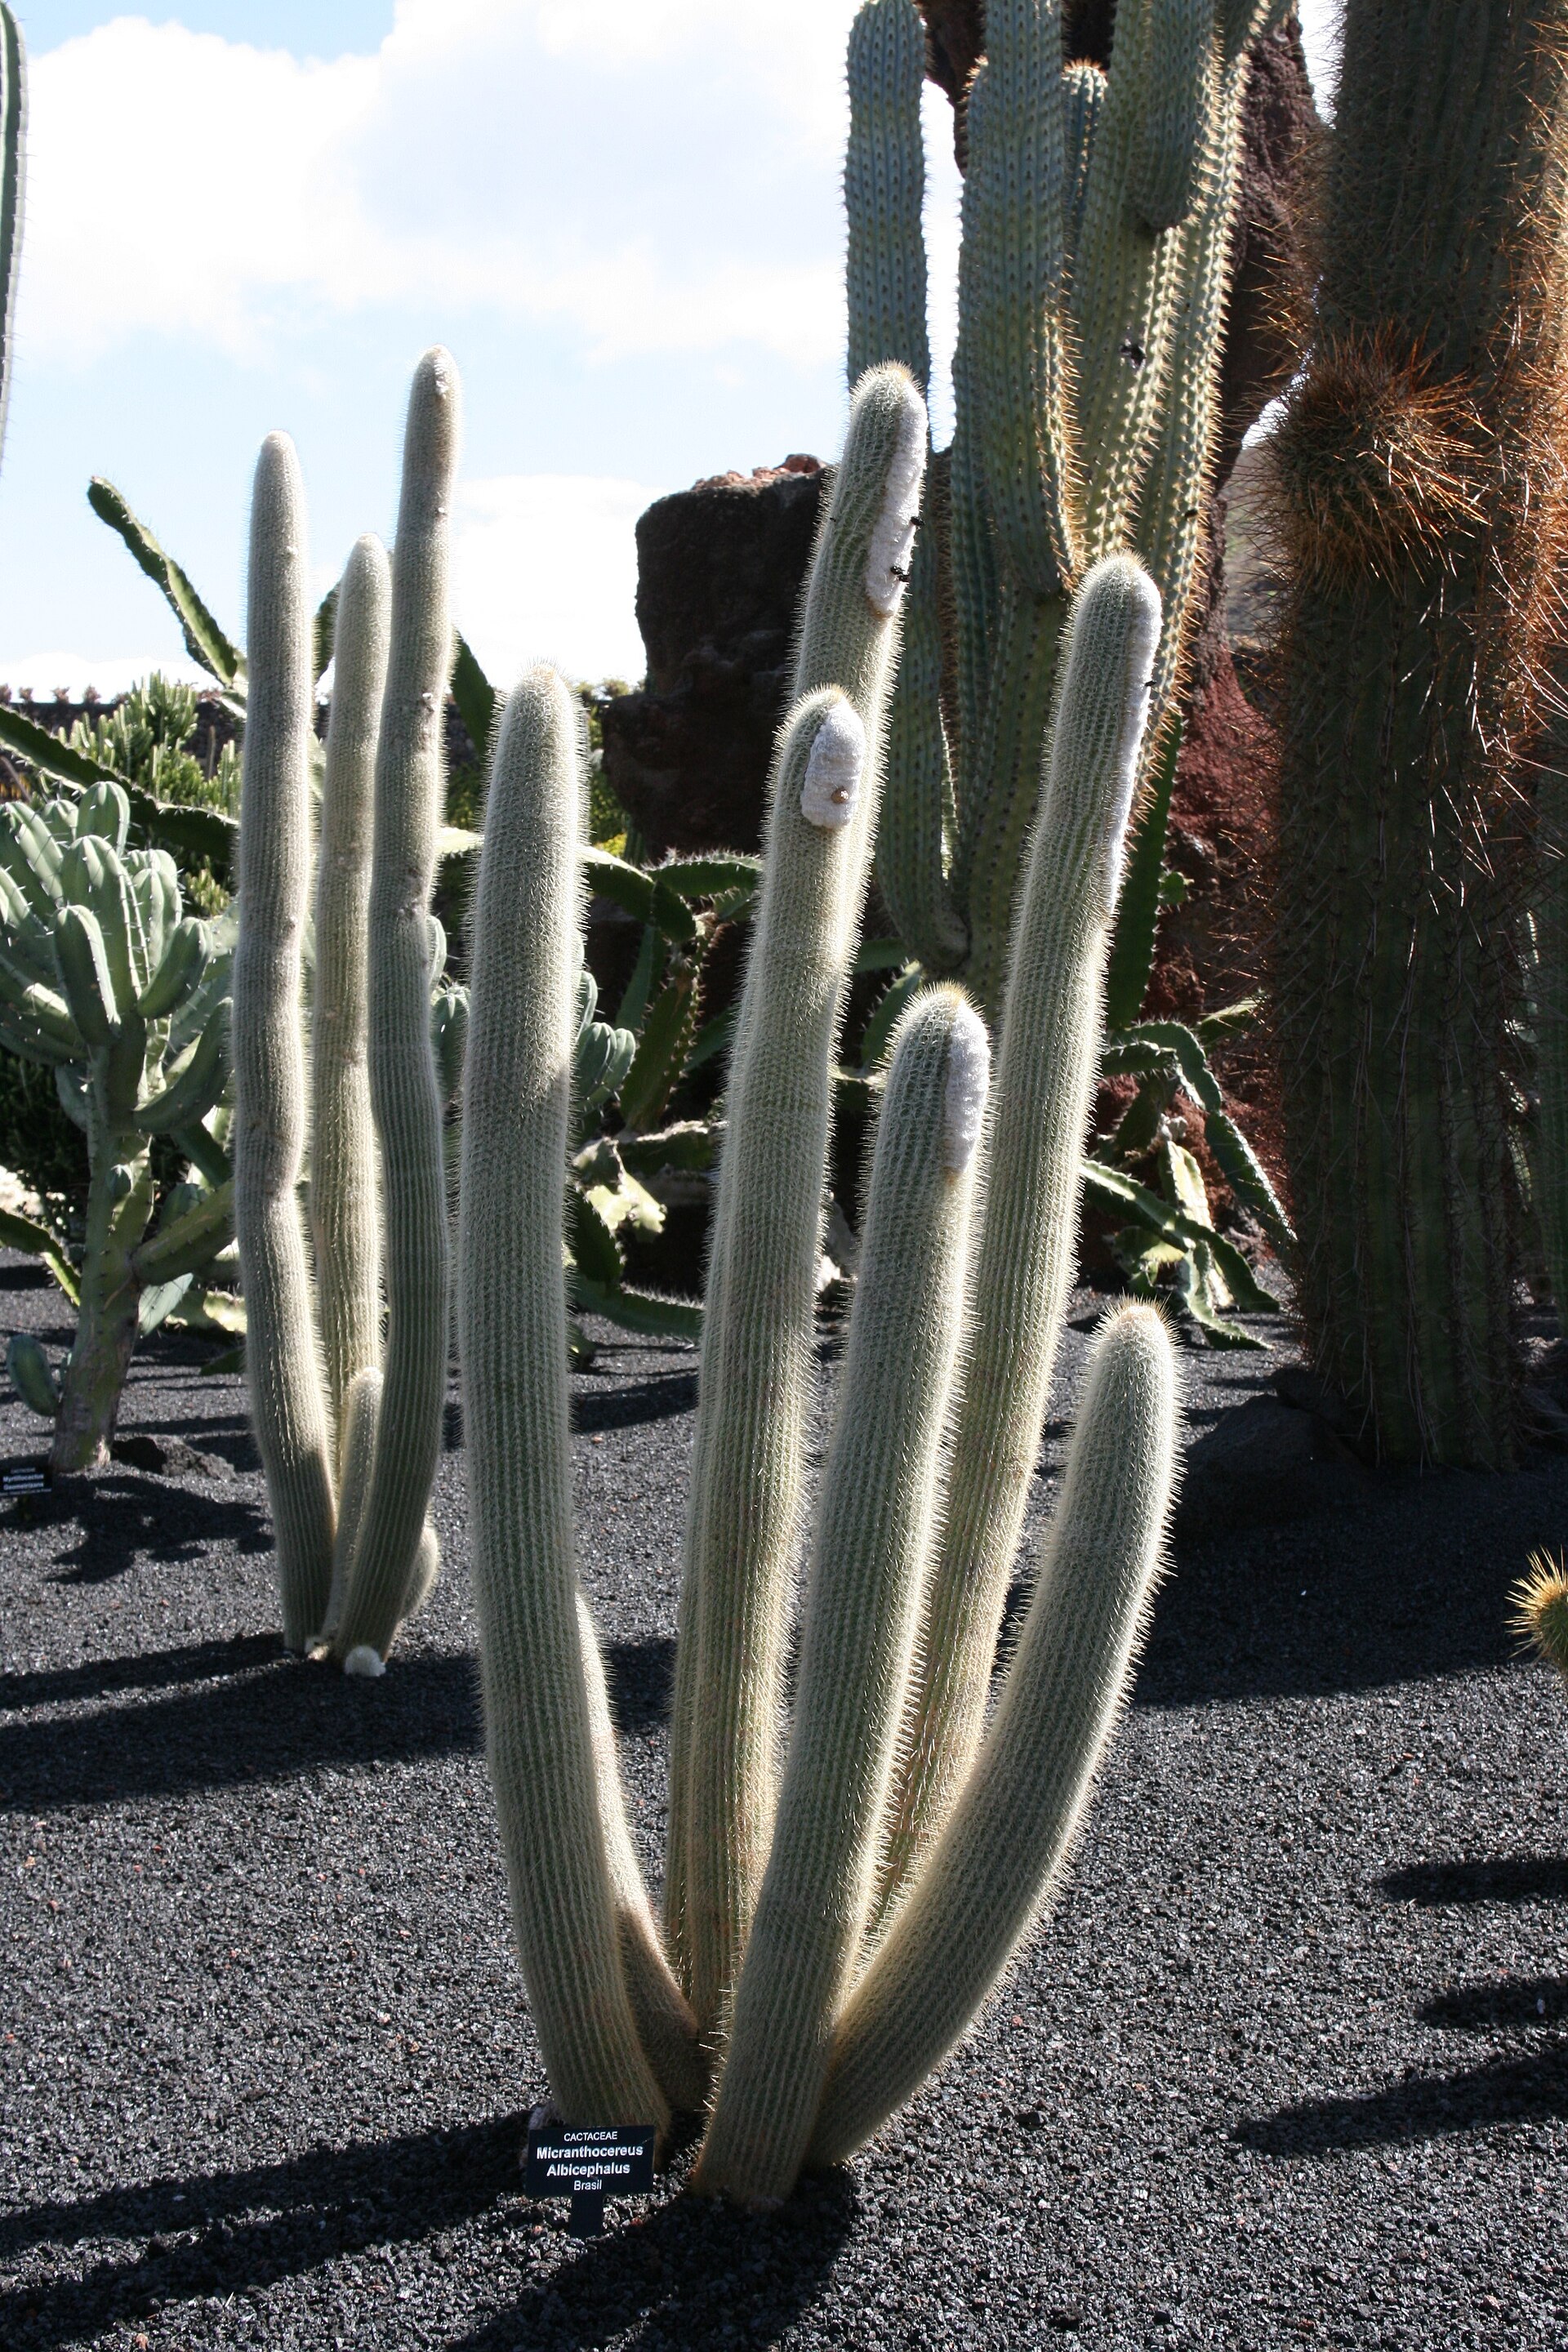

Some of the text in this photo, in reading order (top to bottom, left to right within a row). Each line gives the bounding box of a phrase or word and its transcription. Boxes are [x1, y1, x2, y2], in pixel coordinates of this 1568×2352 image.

[564, 2131, 618, 2142] CACTACEAE
[537, 2145, 644, 2159] Micranthocereus
[546, 2162, 630, 2177] Albicephalus
[573, 2179, 603, 2191] Brasil
